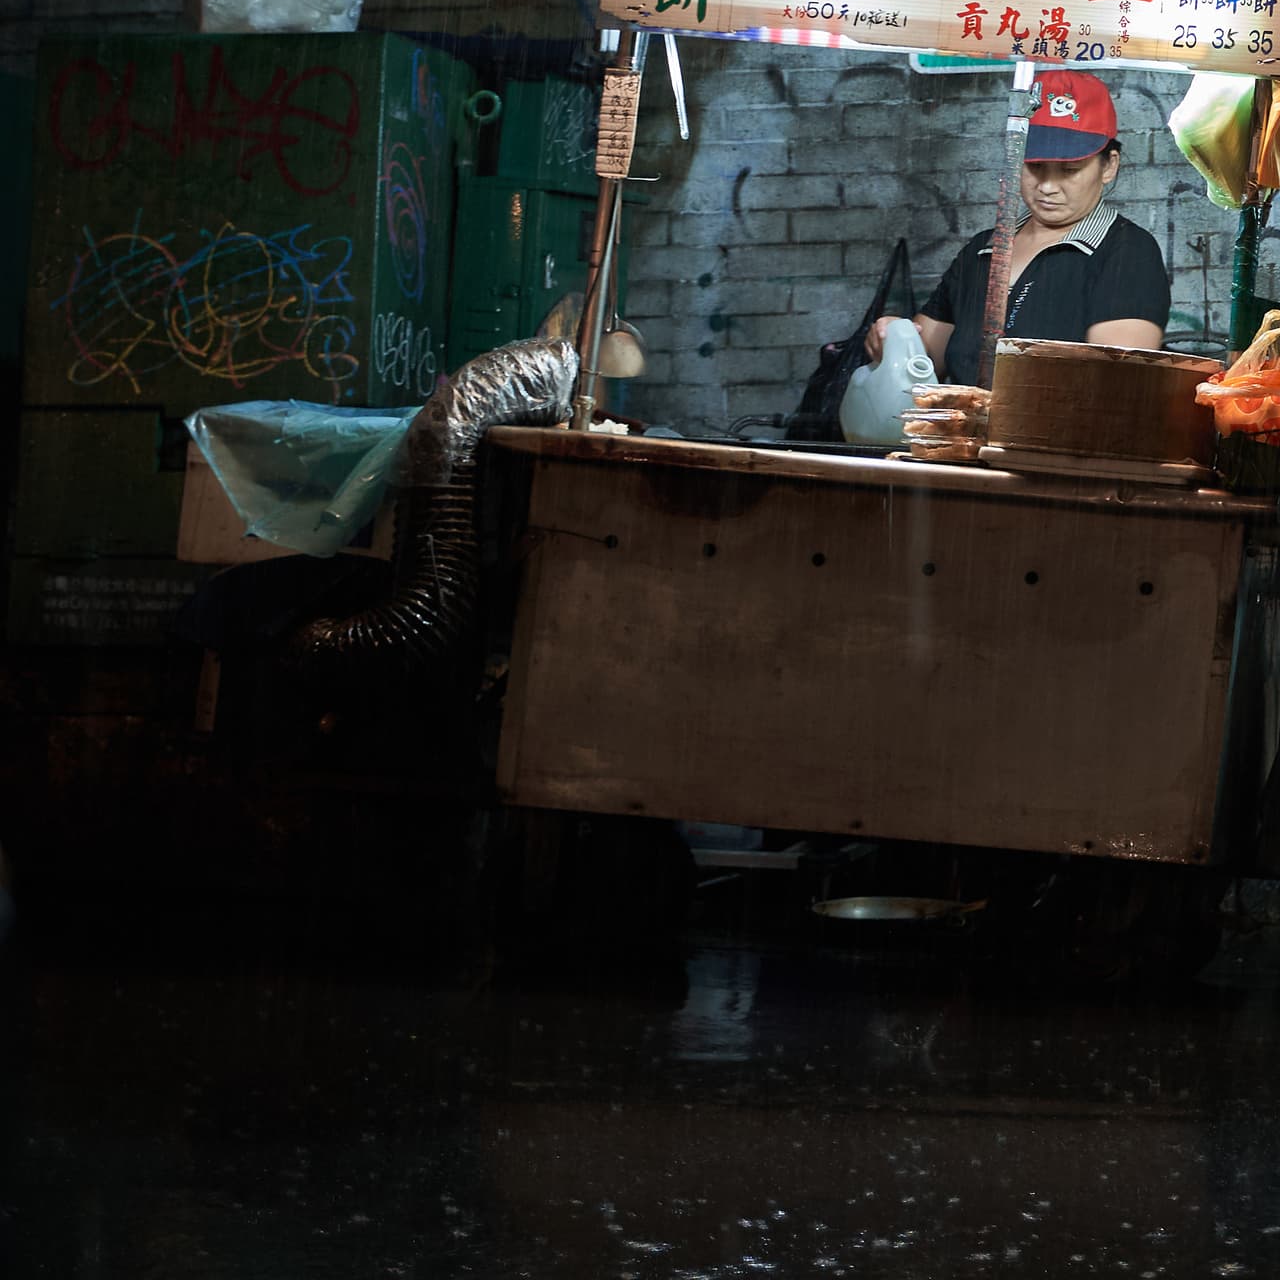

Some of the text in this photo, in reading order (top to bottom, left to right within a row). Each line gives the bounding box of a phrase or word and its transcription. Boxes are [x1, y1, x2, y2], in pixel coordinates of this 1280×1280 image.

[957, 2, 1092, 43] 貢丸湯 30
[1109, 0, 1131, 58] 綜合湯 35
[1173, 24, 1197, 49] 25
[1212, 28, 1239, 50] 35
[1247, 30, 1273, 55] 35
[1011, 37, 1105, 62] 菜頭湯 20
